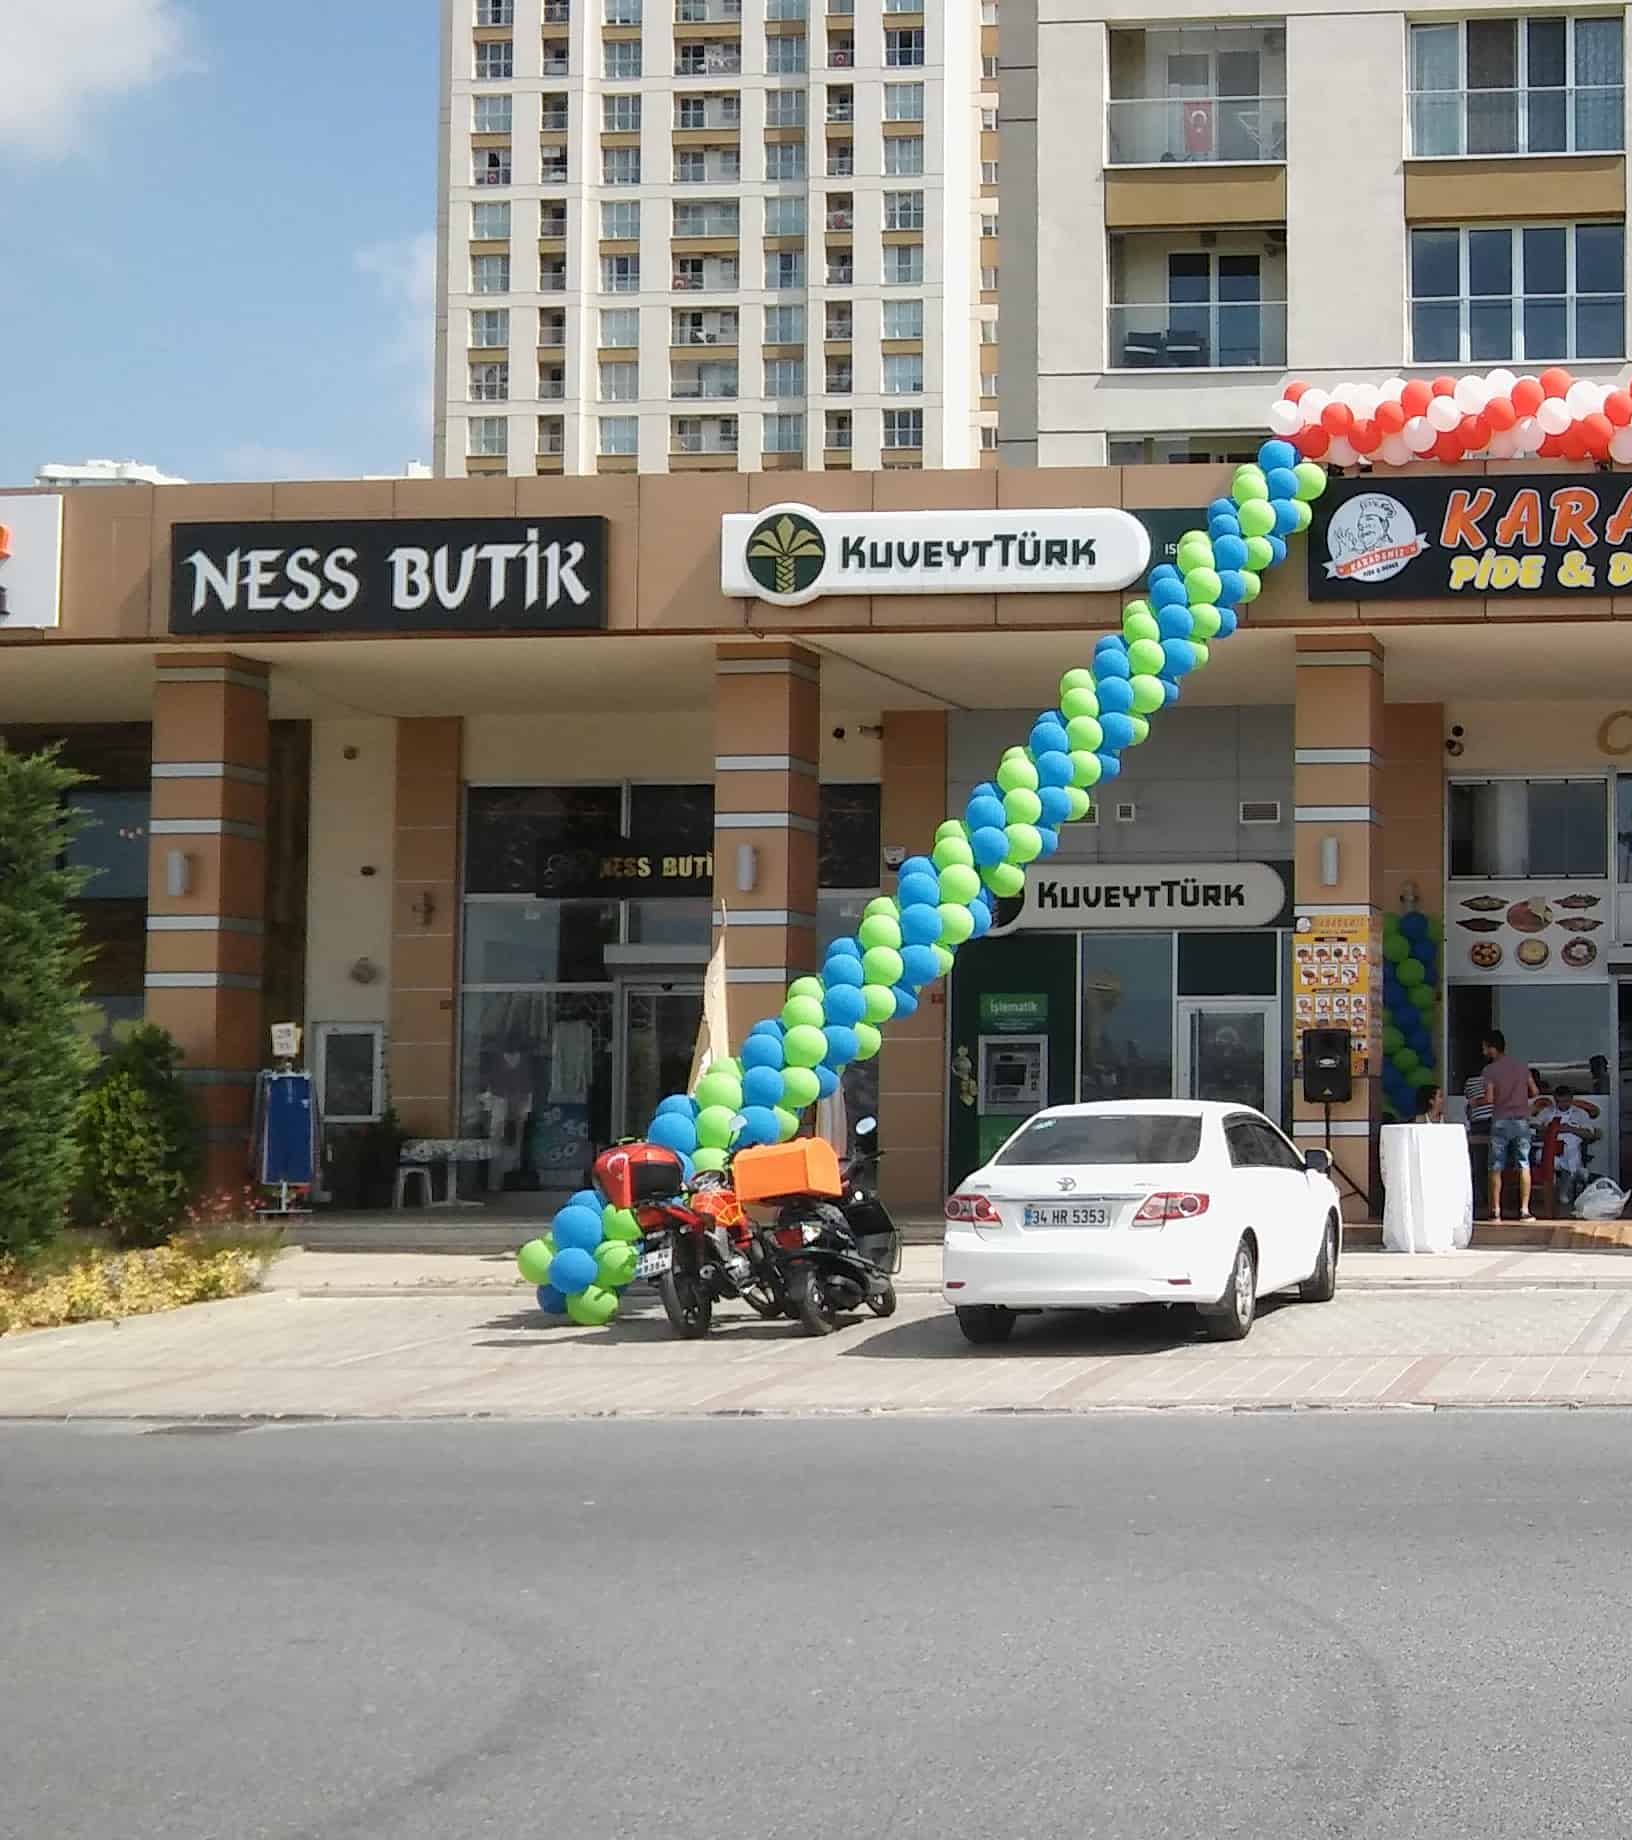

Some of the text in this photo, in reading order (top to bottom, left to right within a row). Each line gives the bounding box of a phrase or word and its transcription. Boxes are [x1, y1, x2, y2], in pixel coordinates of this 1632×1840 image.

[181, 527, 591, 616] NESS BUTİK
[1449, 548, 1546, 590] PİDE
[1557, 550, 1595, 588] &
[662, 851, 713, 878] BUTİ
[1032, 1209, 1105, 1225] 34 HR 5353
